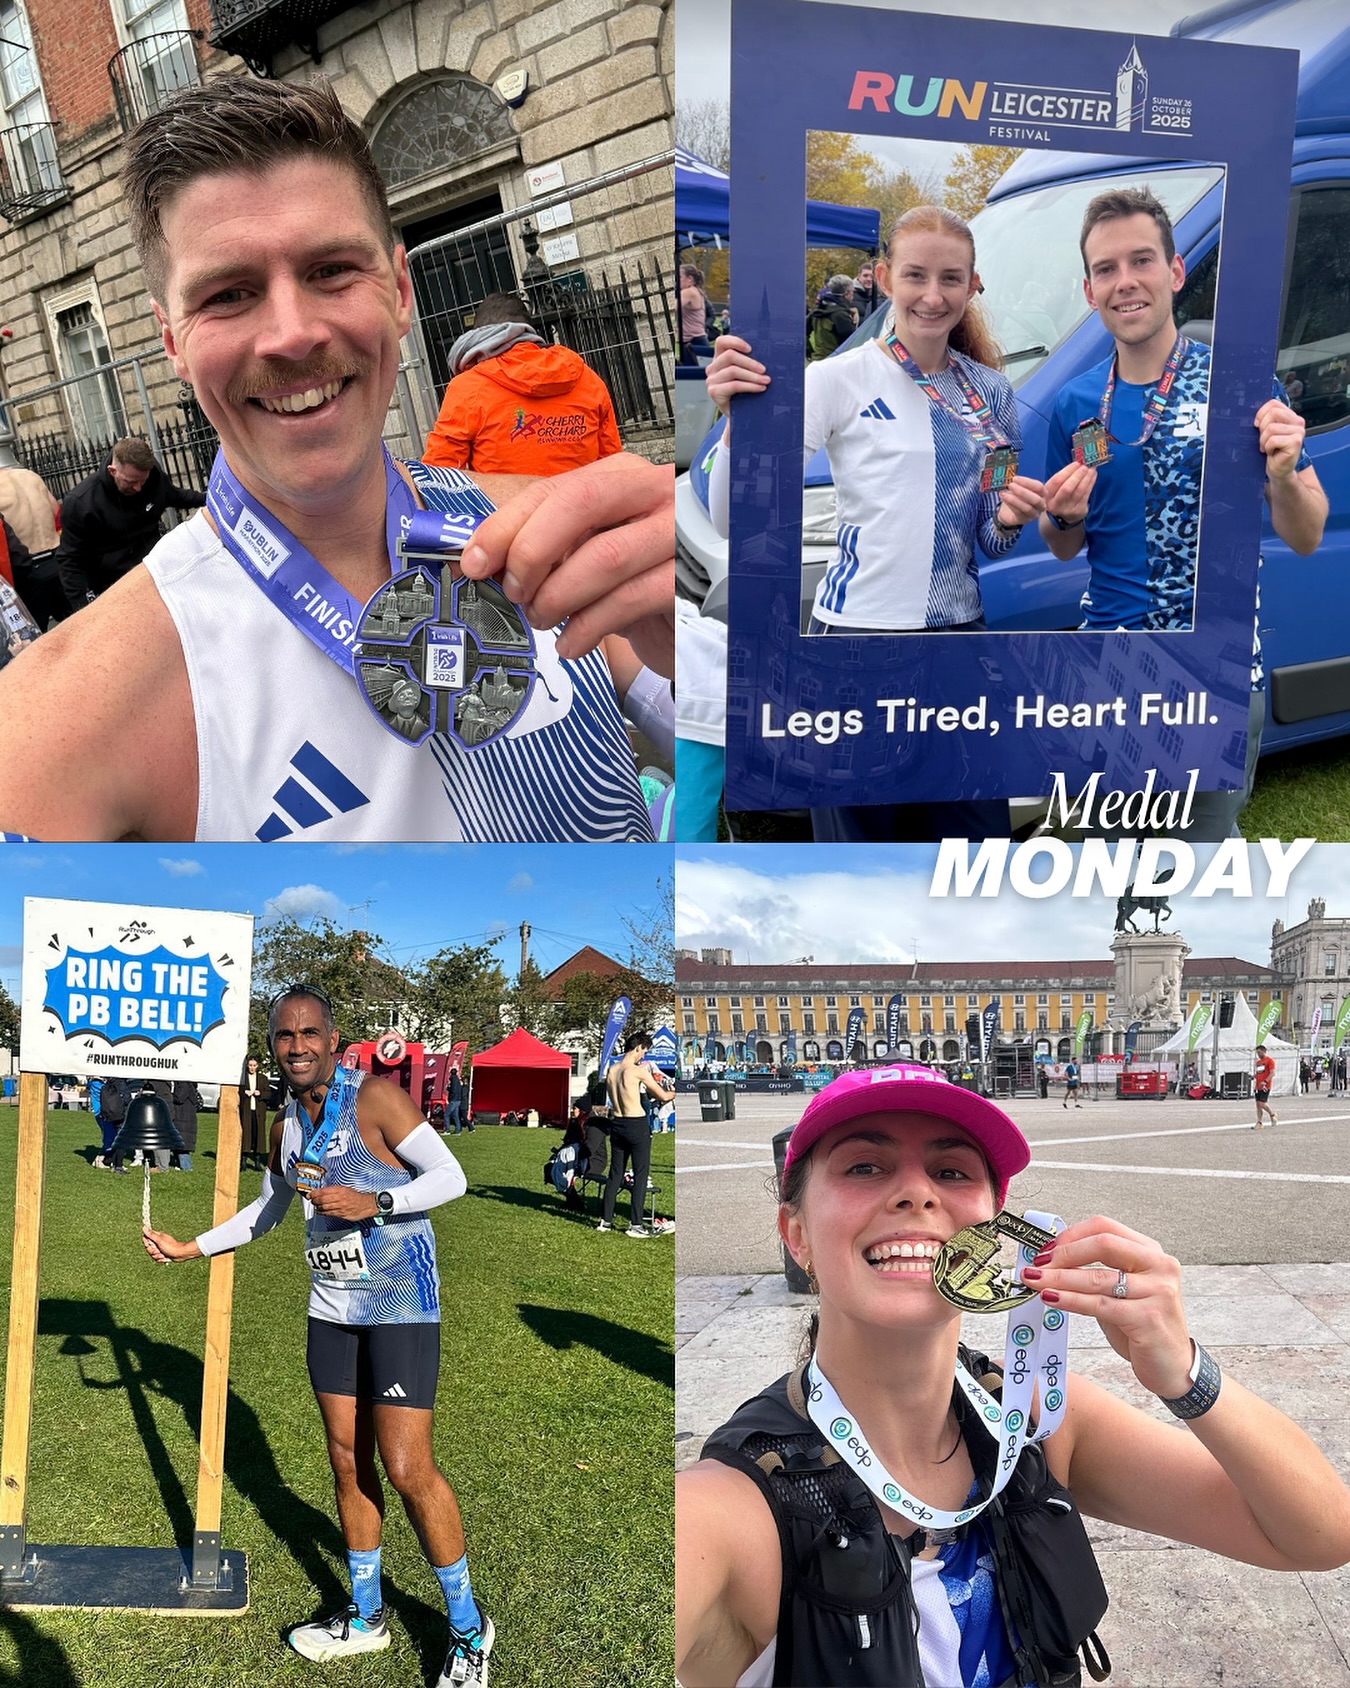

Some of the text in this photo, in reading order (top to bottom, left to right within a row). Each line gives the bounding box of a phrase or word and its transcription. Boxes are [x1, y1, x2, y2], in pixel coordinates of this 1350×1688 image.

[848, 70, 988, 120] RUN
[991, 91, 1113, 122] LEICESTER
[1152, 96, 1193, 107] SUNDAY 26
[1151, 104, 1193, 116] OCTOBER
[1151, 115, 1191, 129] 2025
[989, 126, 1051, 142] FESTIVAL
[537, 426, 587, 437] ORCHARD
[546, 414, 585, 426] CHERRY
[243, 520, 279, 562] DUBLIN
[433, 673, 456, 682] 2025
[761, 692, 1219, 744] Legs Tired, Heart Full.
[119, 926, 155, 935] RunThrough
[66, 957, 208, 997] RING THE
[68, 993, 203, 1032] PB BELL!
[1259, 1006, 1279, 1034] mgen
[890, 1012, 899, 1048] HYUND
[1076, 1019, 1089, 1043] mgen
[1191, 1011, 1208, 1039] mgen
[86, 1053, 179, 1070] #RUNTHROUGHUK
[330, 1082, 342, 1102] 2025
[308, 1248, 363, 1270] 1844
[1009, 1349, 1030, 1385] edp
[1041, 1355, 1062, 1387] edp
[968, 1382, 989, 1405] edp
[847, 1437, 872, 1468] edp
[1002, 1435, 1017, 1471] edp
[901, 1500, 933, 1521] edp
